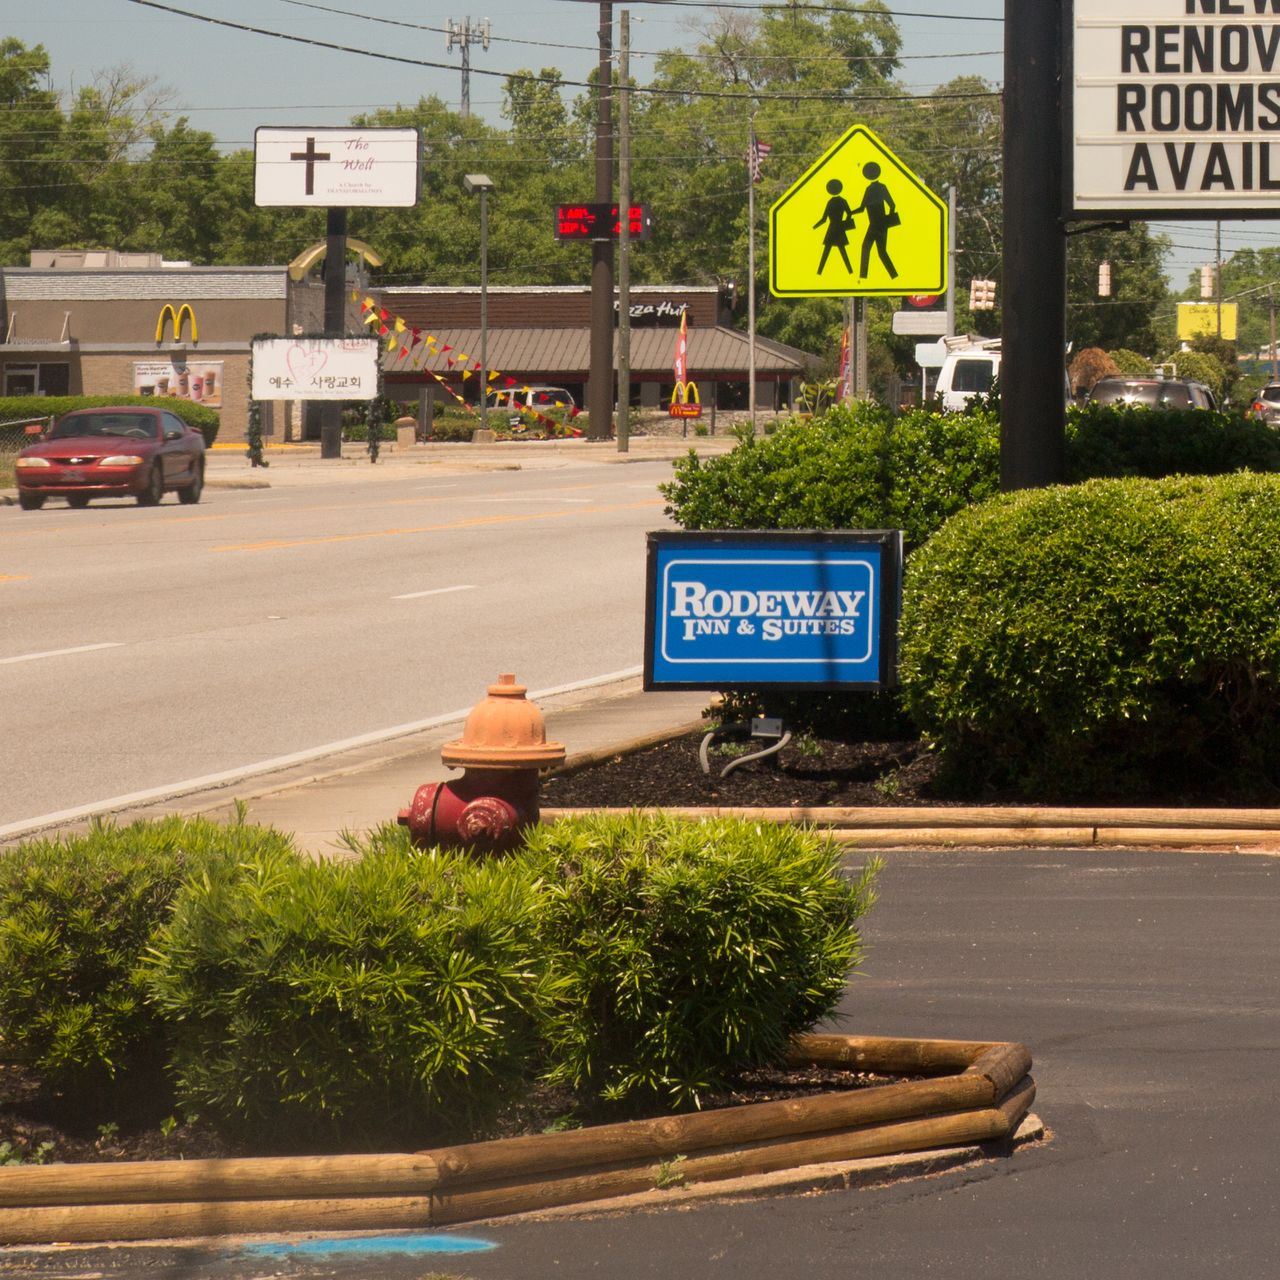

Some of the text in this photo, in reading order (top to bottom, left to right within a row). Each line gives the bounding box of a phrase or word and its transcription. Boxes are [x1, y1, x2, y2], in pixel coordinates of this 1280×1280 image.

[269, 376, 361, 389] 예수 사랑교회
[670, 581, 865, 617] RODEWAY
[682, 618, 855, 641] INN & SUITES
